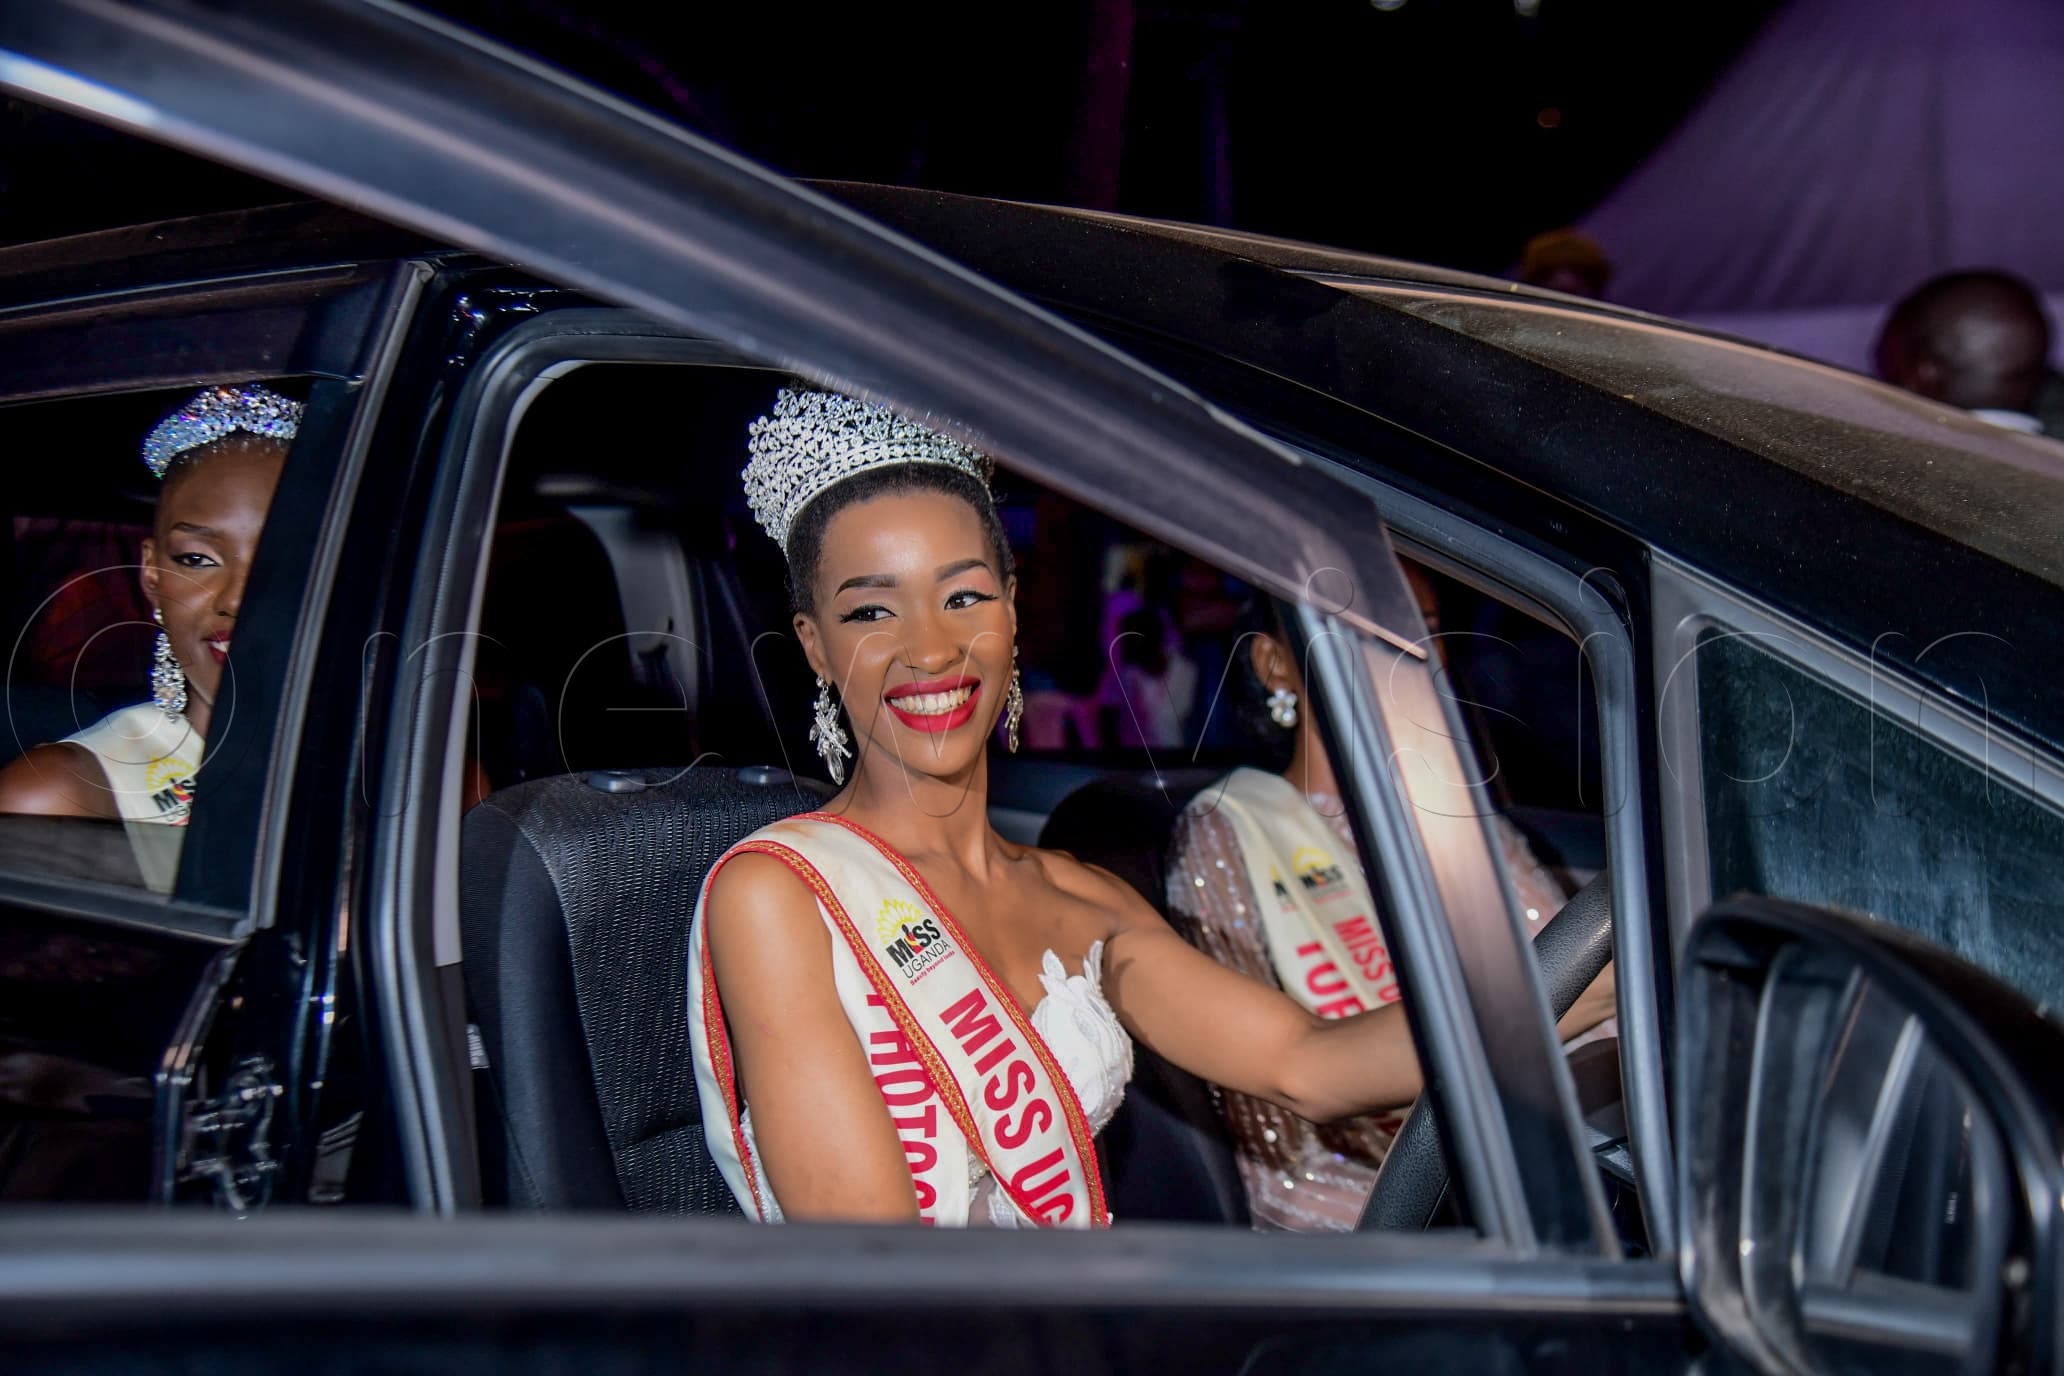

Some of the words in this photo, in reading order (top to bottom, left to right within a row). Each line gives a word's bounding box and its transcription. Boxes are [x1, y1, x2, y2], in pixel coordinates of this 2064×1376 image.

[902, 940, 951, 979] UGANDA
[1333, 914, 1395, 981] MISS
[939, 987, 1054, 1150] MISS
